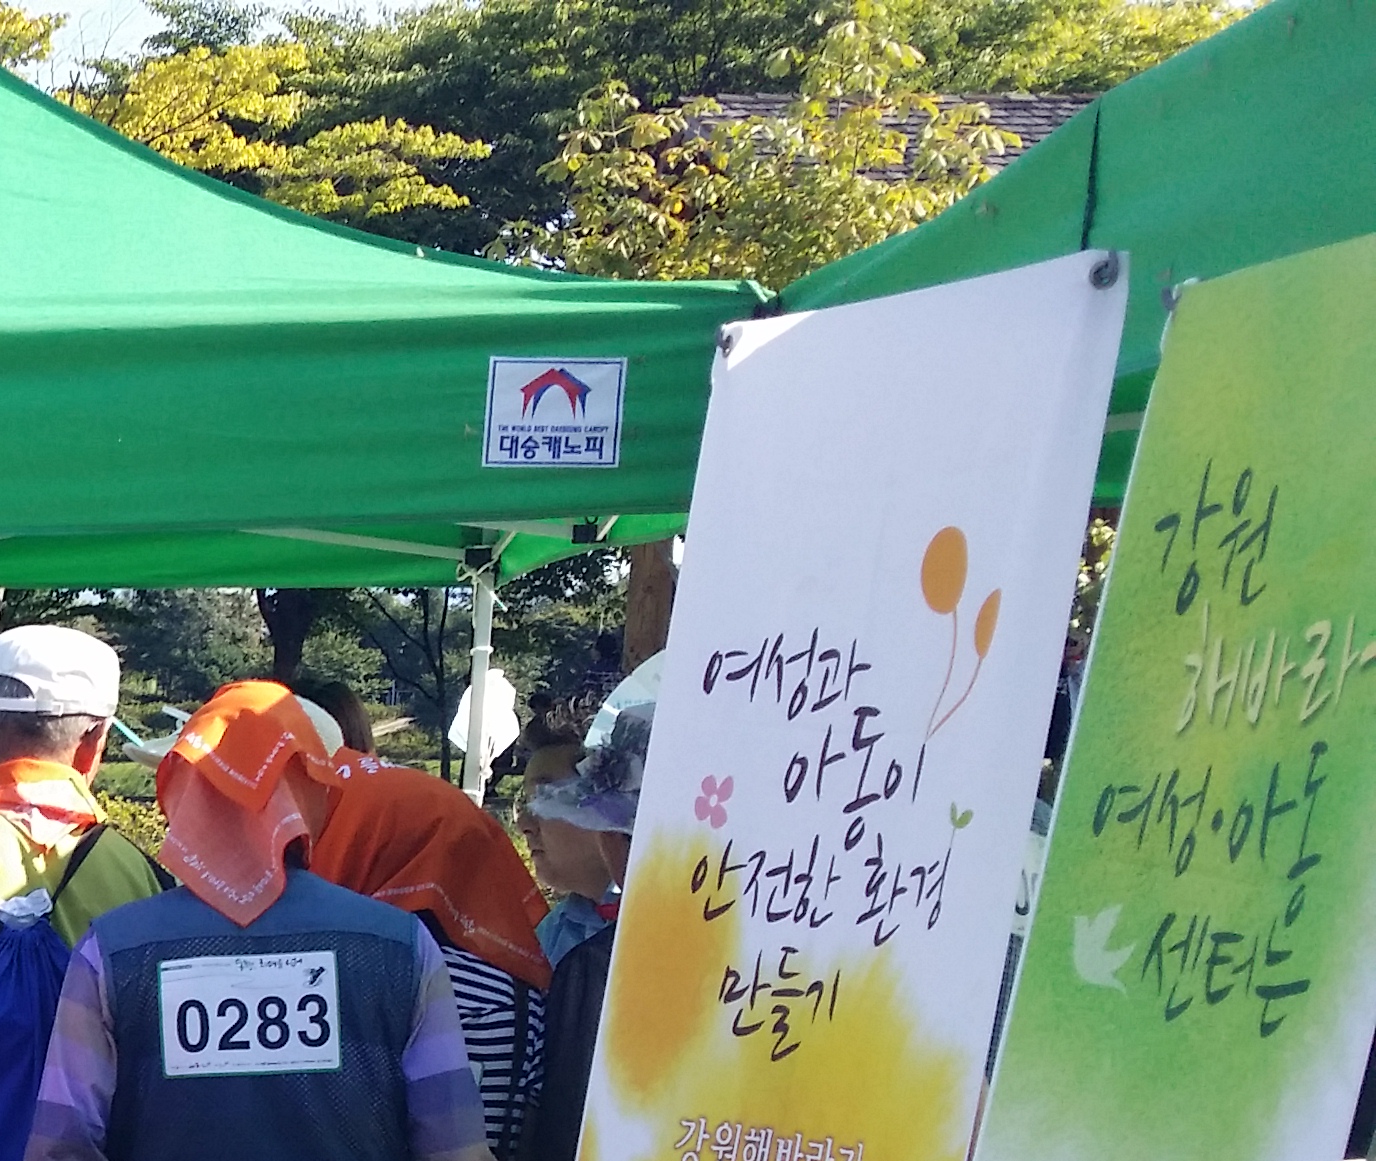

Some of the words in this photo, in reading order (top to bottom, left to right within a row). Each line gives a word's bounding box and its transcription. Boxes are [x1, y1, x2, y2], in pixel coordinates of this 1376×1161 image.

[1153, 458, 1278, 616] 강원
[702, 627, 872, 721] 여성과
[1173, 601, 1376, 736] 해바라
[783, 705, 926, 851] 아동이
[1090, 739, 1330, 929] 여성·아동
[690, 834, 841, 929] 안전한
[855, 832, 952, 947] 환경
[176, 993, 331, 1054] 0283
[718, 946, 842, 1062] 만들기
[1139, 911, 1310, 1038] 센터는
